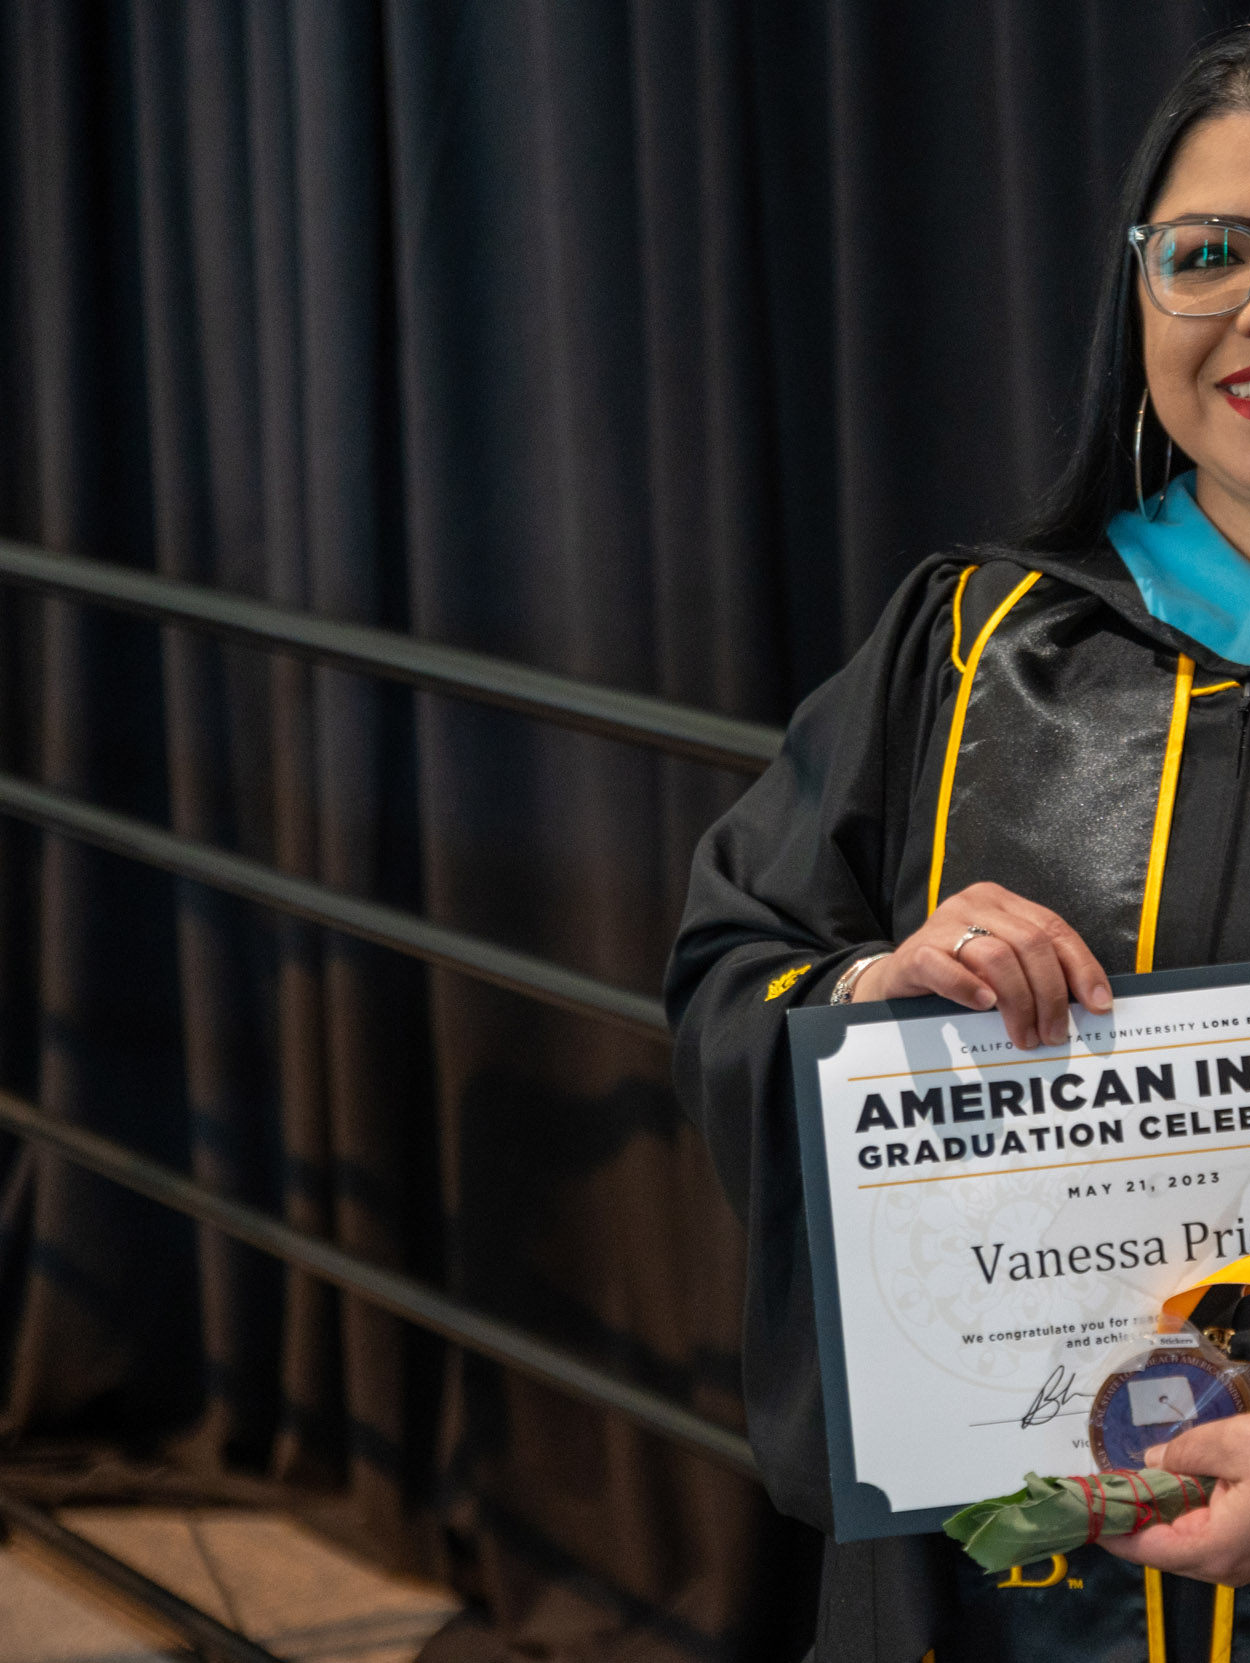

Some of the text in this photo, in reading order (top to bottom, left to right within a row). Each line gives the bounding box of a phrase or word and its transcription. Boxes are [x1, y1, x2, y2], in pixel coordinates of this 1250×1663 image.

[961, 1041, 1013, 1054] CALIFO
[1067, 1032, 1101, 1043] TATE
[1109, 1022, 1195, 1039] UNIVERSITY
[1203, 1018, 1240, 1029] LONG
[855, 1063, 1176, 1133] AMERICAN
[858, 1119, 1124, 1170] GRADUATION
[1068, 1172, 1220, 1199] MAY 21, 2023
[971, 1236, 1168, 1285] Vanessa
[962, 1335, 983, 1345] We
[989, 1323, 1075, 1344] congratulate
[1081, 1319, 1105, 1333] you
[1109, 1316, 1129, 1328] for
[1066, 1336, 1091, 1349] and
[1160, 1337, 1194, 1345] Stickers
